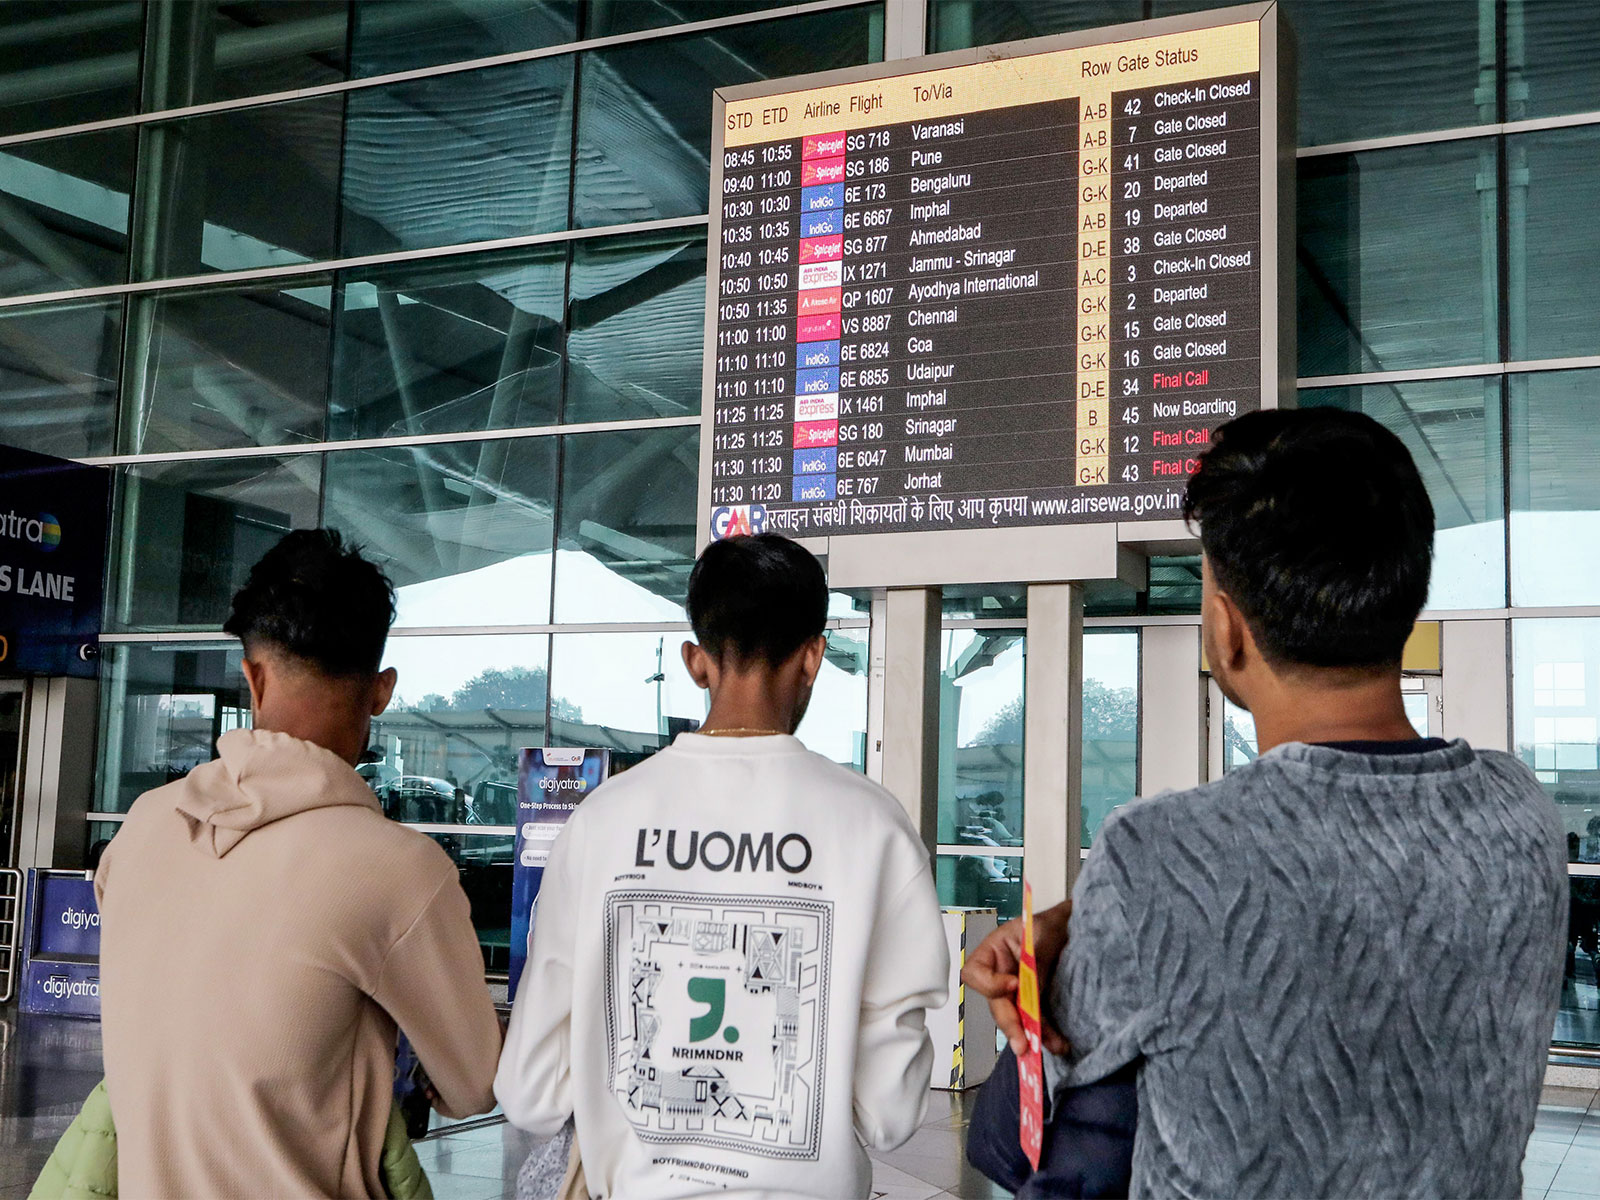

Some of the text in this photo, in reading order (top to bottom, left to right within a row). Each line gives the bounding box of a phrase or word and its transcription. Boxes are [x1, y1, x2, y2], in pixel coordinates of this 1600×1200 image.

[727, 48, 1198, 130] STD ETD Airline Flight To/Via Row Gate Status
[725, 80, 1250, 168] 08:45 10:55 SG 718 Varanasi A-B 42 Check-In Closed
[724, 111, 1226, 193] 09:40 11:00 SG 186 Pune A-B 7 Gate Closed
[724, 140, 1226, 218] 10:30 10:30 6E 173 Bengaluru G-K 41 Gate Closed
[722, 198, 1207, 269] 10:40 10:45 SG 877 Ahmedabad A-B 19 Departed
[723, 170, 1207, 244] 10:35 10:35 6E 6667 Imphal G-K 20 Departed
[720, 251, 1250, 320] 10:50 11:35 QP 1607 Ayodhya International A-C 3 Check-In Closed
[721, 225, 1226, 295] 10:50 10:50 IX 1271 Jammu Srinagar D-E 38 Gate Closed
[718, 310, 1226, 372] 11:10 11:10 6E 6824 Goa G-K 15 Gate Closed
[719, 329, 749, 346] 11:00
[756, 325, 786, 342] 11:00
[842, 318, 859, 334] VS
[862, 314, 891, 332] 8887
[908, 306, 957, 326] Chennai
[1081, 296, 1107, 313] G-K
[1127, 293, 1136, 310] 2
[1154, 284, 1207, 305] Departed
[717, 340, 1226, 398] 11:10 11:10 6E 6855 Udaipur G-K 16 Gate Closed
[716, 370, 1208, 424] 11:25 11:25 IX 1461 Imphal D-E 34 Final Call
[715, 398, 1236, 450] 11:25 11:25 SG 180 Srinagar B 45 Now Boarding
[714, 428, 1209, 476] 11:30 11:30 6E 6047 Mumbai G-K 12 Final Call
[713, 486, 743, 502] 11:30
[751, 483, 781, 500] 11:20
[837, 479, 853, 495] 6E
[857, 477, 879, 494] 767
[904, 472, 942, 489] Jorhat
[1080, 466, 1105, 484] G-K
[1122, 465, 1139, 482] 43
[1152, 459, 1182, 476] Final
[1031, 488, 1179, 515] www.airsewa.gov.in
[0, 510, 44, 543] tra
[711, 504, 766, 541] GMR
[812, 499, 847, 527] संबंधी
[911, 496, 925, 522] के
[928, 494, 954, 523] लिए
[958, 498, 985, 519] आप
[989, 496, 1028, 524] कृपया
[17, 568, 75, 602] LANE
[520, 802, 542, 810] One-Step
[543, 802, 561, 810] Process
[562, 802, 568, 810] to
[539, 777, 580, 792] digiyatra
[43, 976, 99, 999] digiyatra
[672, 1047, 743, 1062] NRIMNDNR
